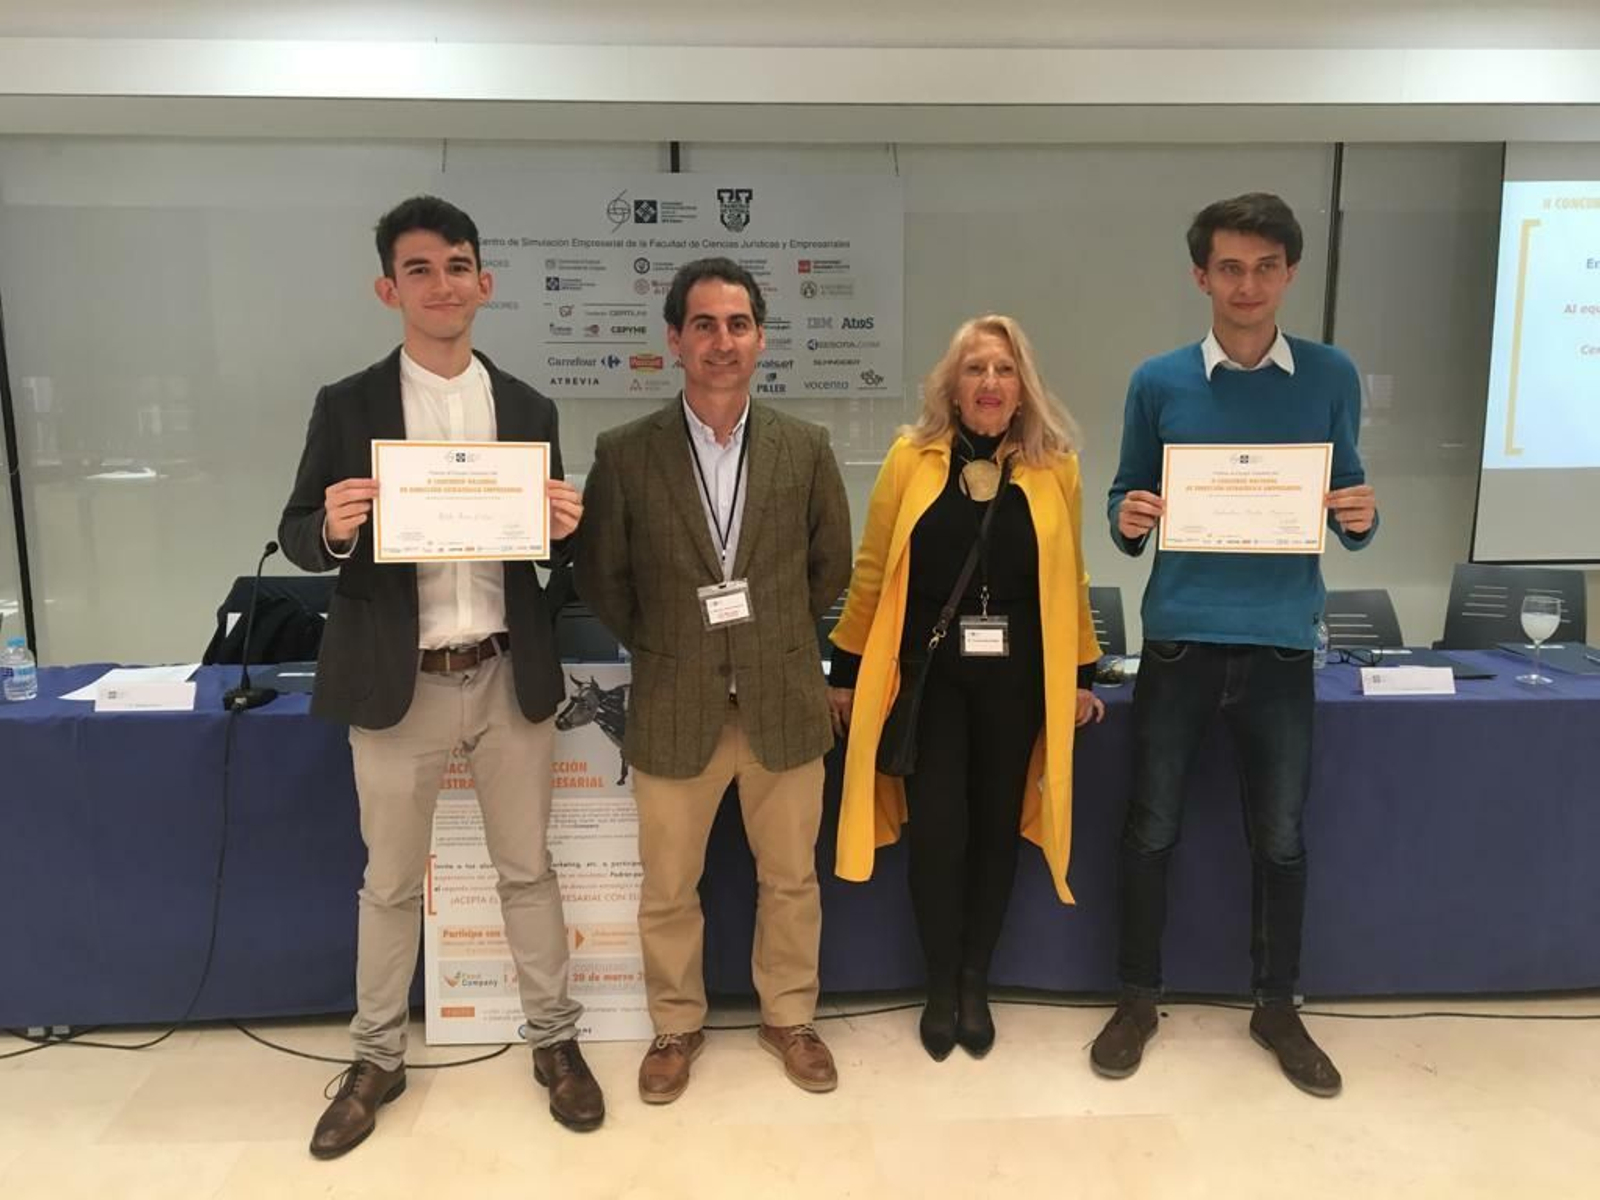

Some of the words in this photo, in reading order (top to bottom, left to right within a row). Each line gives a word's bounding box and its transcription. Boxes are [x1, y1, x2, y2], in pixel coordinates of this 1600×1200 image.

[572, 239, 624, 249] Empresarial
[626, 239, 637, 247] de
[650, 239, 687, 248] Facultad
[688, 239, 700, 248] de
[702, 239, 739, 248] Ciencias
[790, 239, 850, 249] Empresariales
[547, 356, 597, 367] Carrefour
[550, 377, 599, 385] ATREVIA
